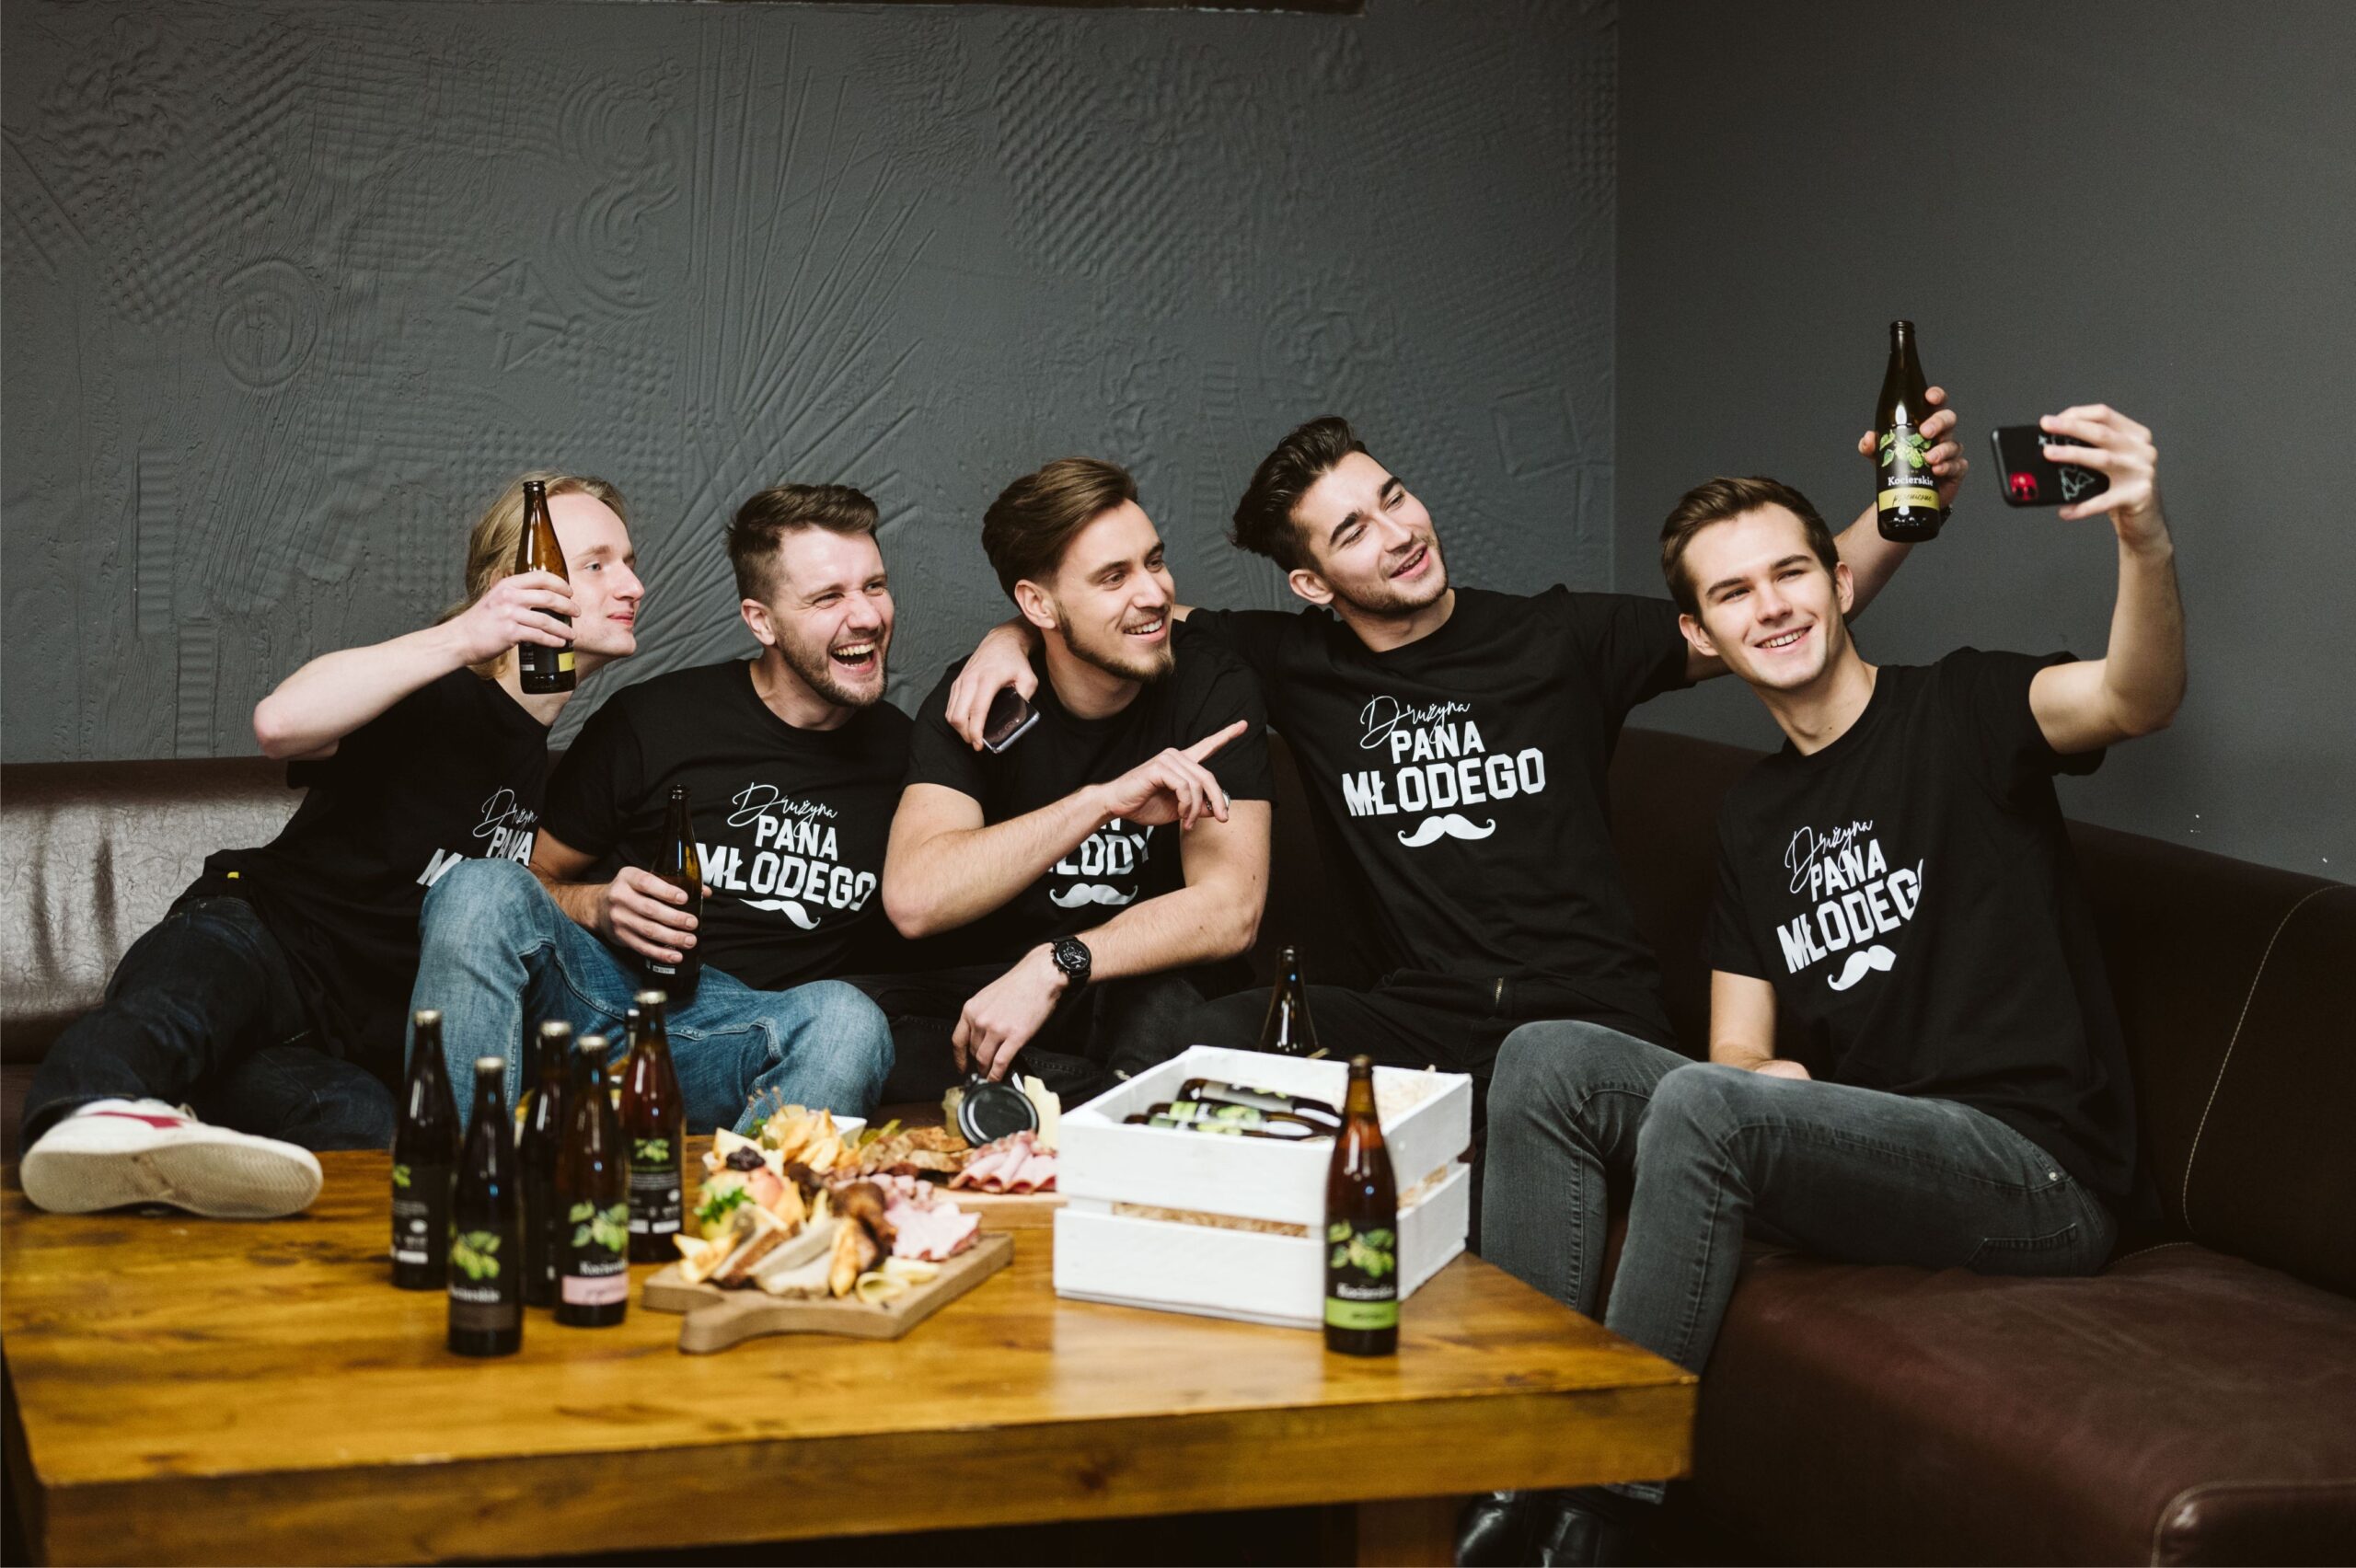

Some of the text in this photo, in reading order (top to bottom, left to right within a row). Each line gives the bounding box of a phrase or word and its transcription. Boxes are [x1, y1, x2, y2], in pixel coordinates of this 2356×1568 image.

[1359, 694, 1471, 749] Drużyna
[1391, 721, 1486, 764] PANA
[727, 782, 838, 838] Drużyna
[1342, 747, 1546, 817] MŁODEGO
[755, 815, 838, 861] PANA
[1784, 820, 1874, 894] Drużyna
[1810, 838, 1888, 903] PANA
[696, 842, 877, 912] MŁODEGO
[1776, 858, 1924, 974] MŁODEG
